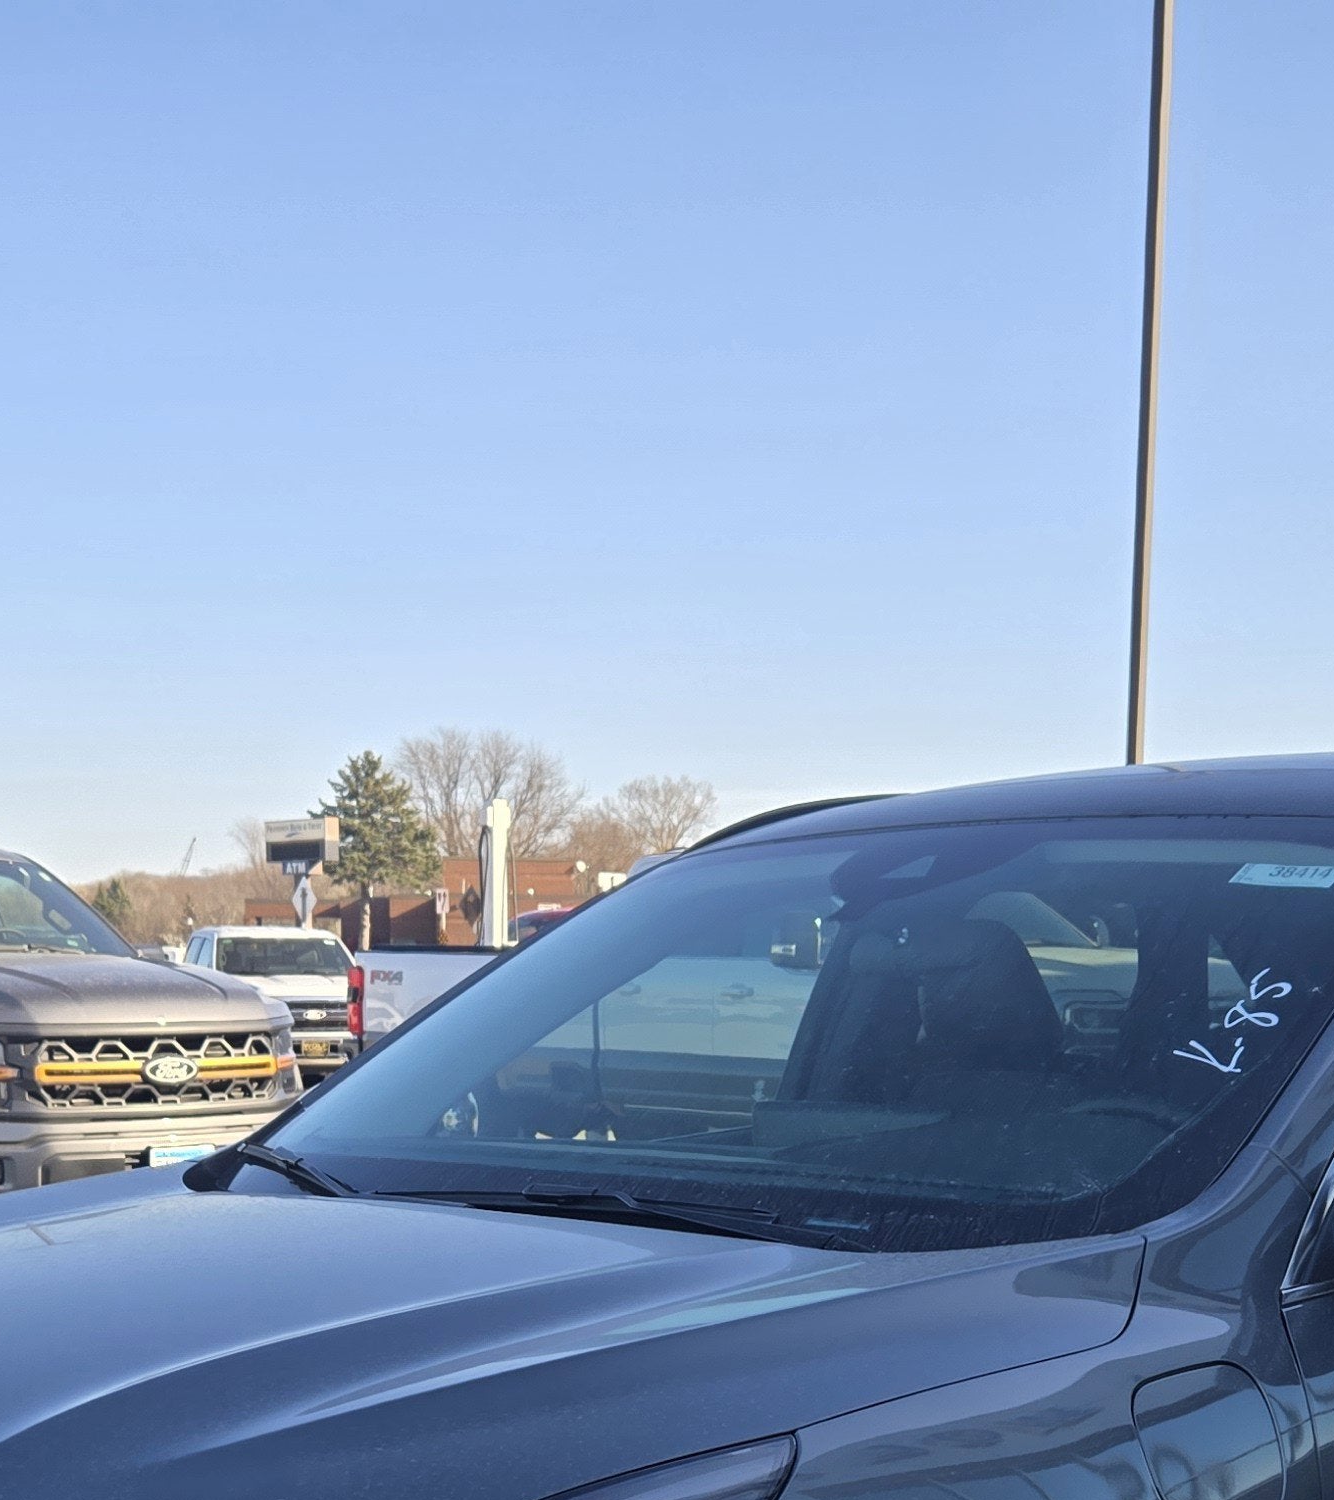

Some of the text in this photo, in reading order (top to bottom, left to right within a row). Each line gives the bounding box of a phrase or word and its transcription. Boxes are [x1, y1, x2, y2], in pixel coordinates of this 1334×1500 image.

[286, 862, 306, 875] ATM
[1269, 865, 1334, 880] 38414
[370, 970, 404, 986] FX4
